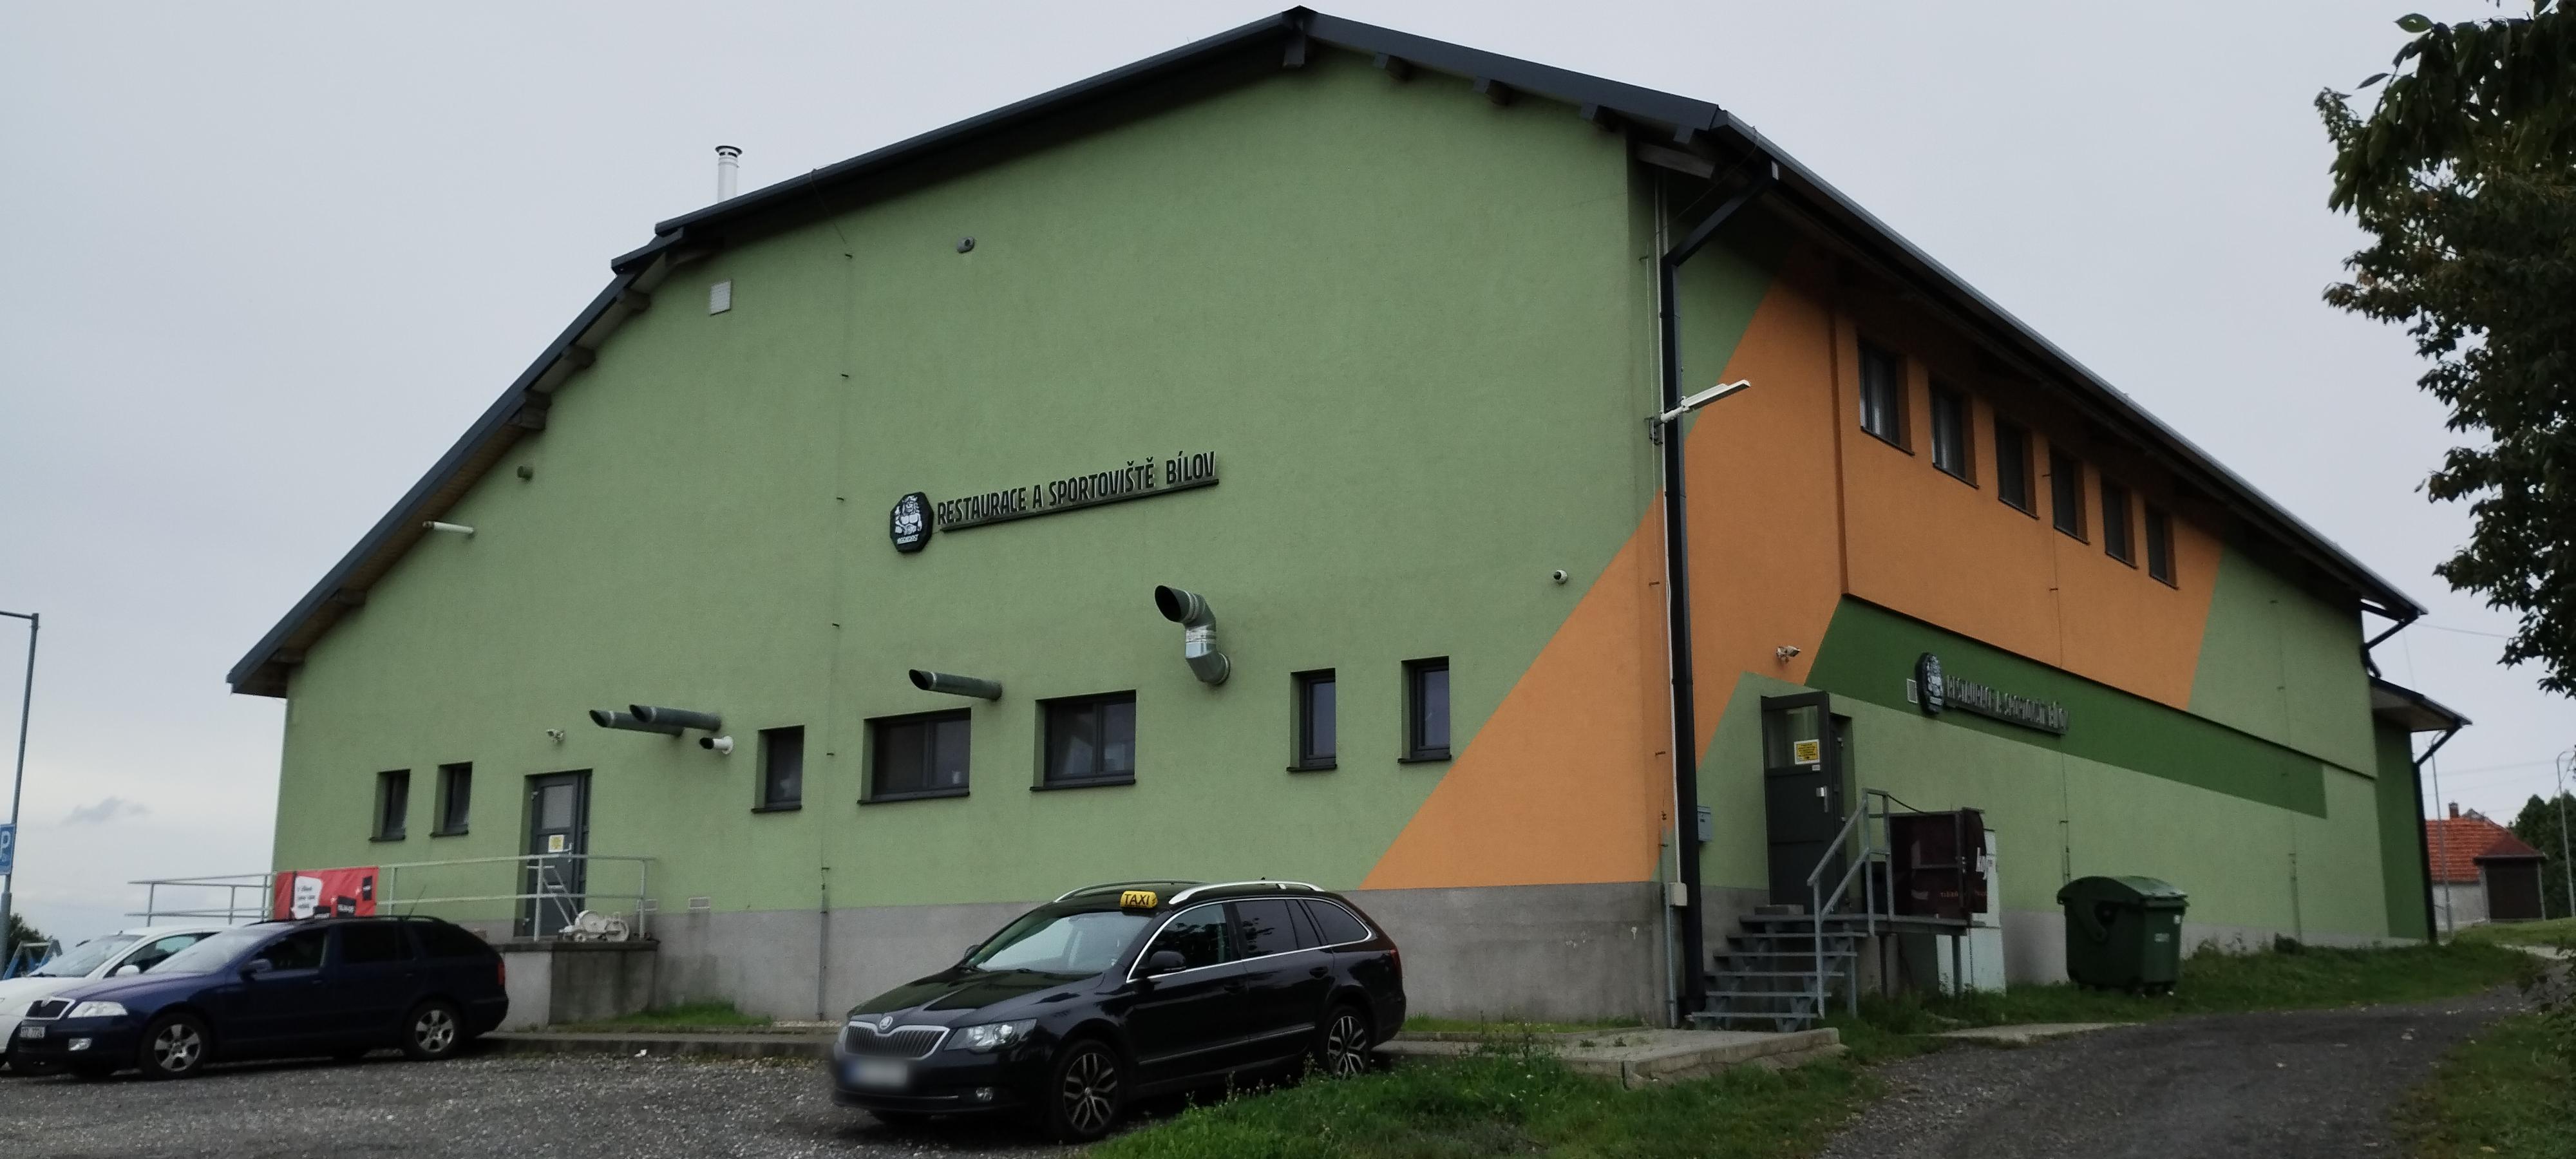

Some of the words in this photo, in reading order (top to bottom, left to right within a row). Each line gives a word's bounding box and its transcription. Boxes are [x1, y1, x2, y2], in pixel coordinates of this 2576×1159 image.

[937, 487, 1027, 525] RESTAURACE
[1032, 484, 1044, 508] A
[1048, 457, 1155, 506] SPORTOVIŠTĚ
[1166, 451, 1216, 485] BÍLOV
[0, 830, 11, 859] P
[1124, 894, 1150, 905] TAXI
